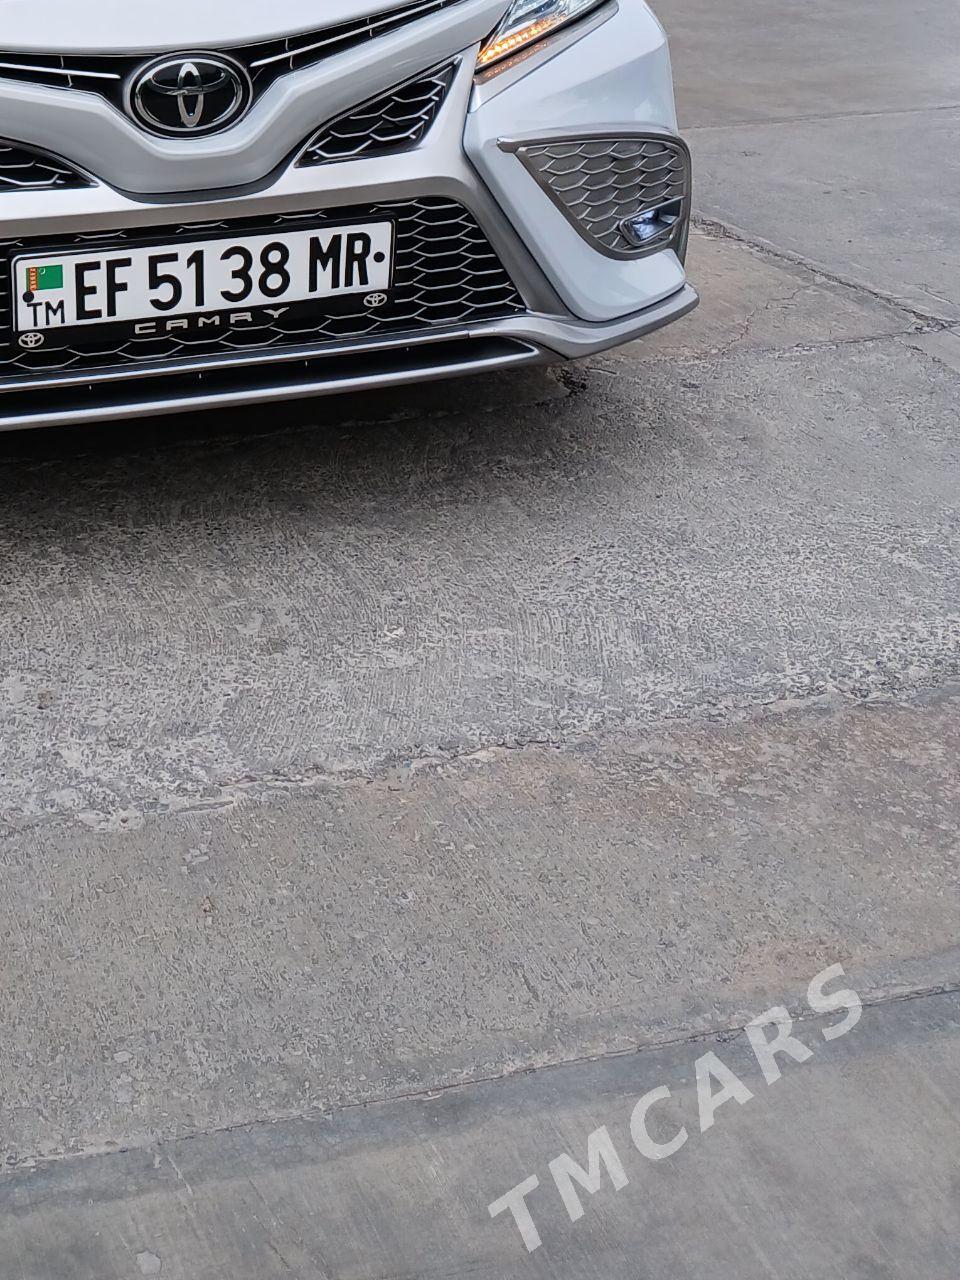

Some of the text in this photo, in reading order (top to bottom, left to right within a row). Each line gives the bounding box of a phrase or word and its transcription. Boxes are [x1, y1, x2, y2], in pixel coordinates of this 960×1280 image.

[74, 232, 372, 321] EF 5138 MR
[26, 299, 65, 327] TM
[134, 306, 290, 334] CAMRY
